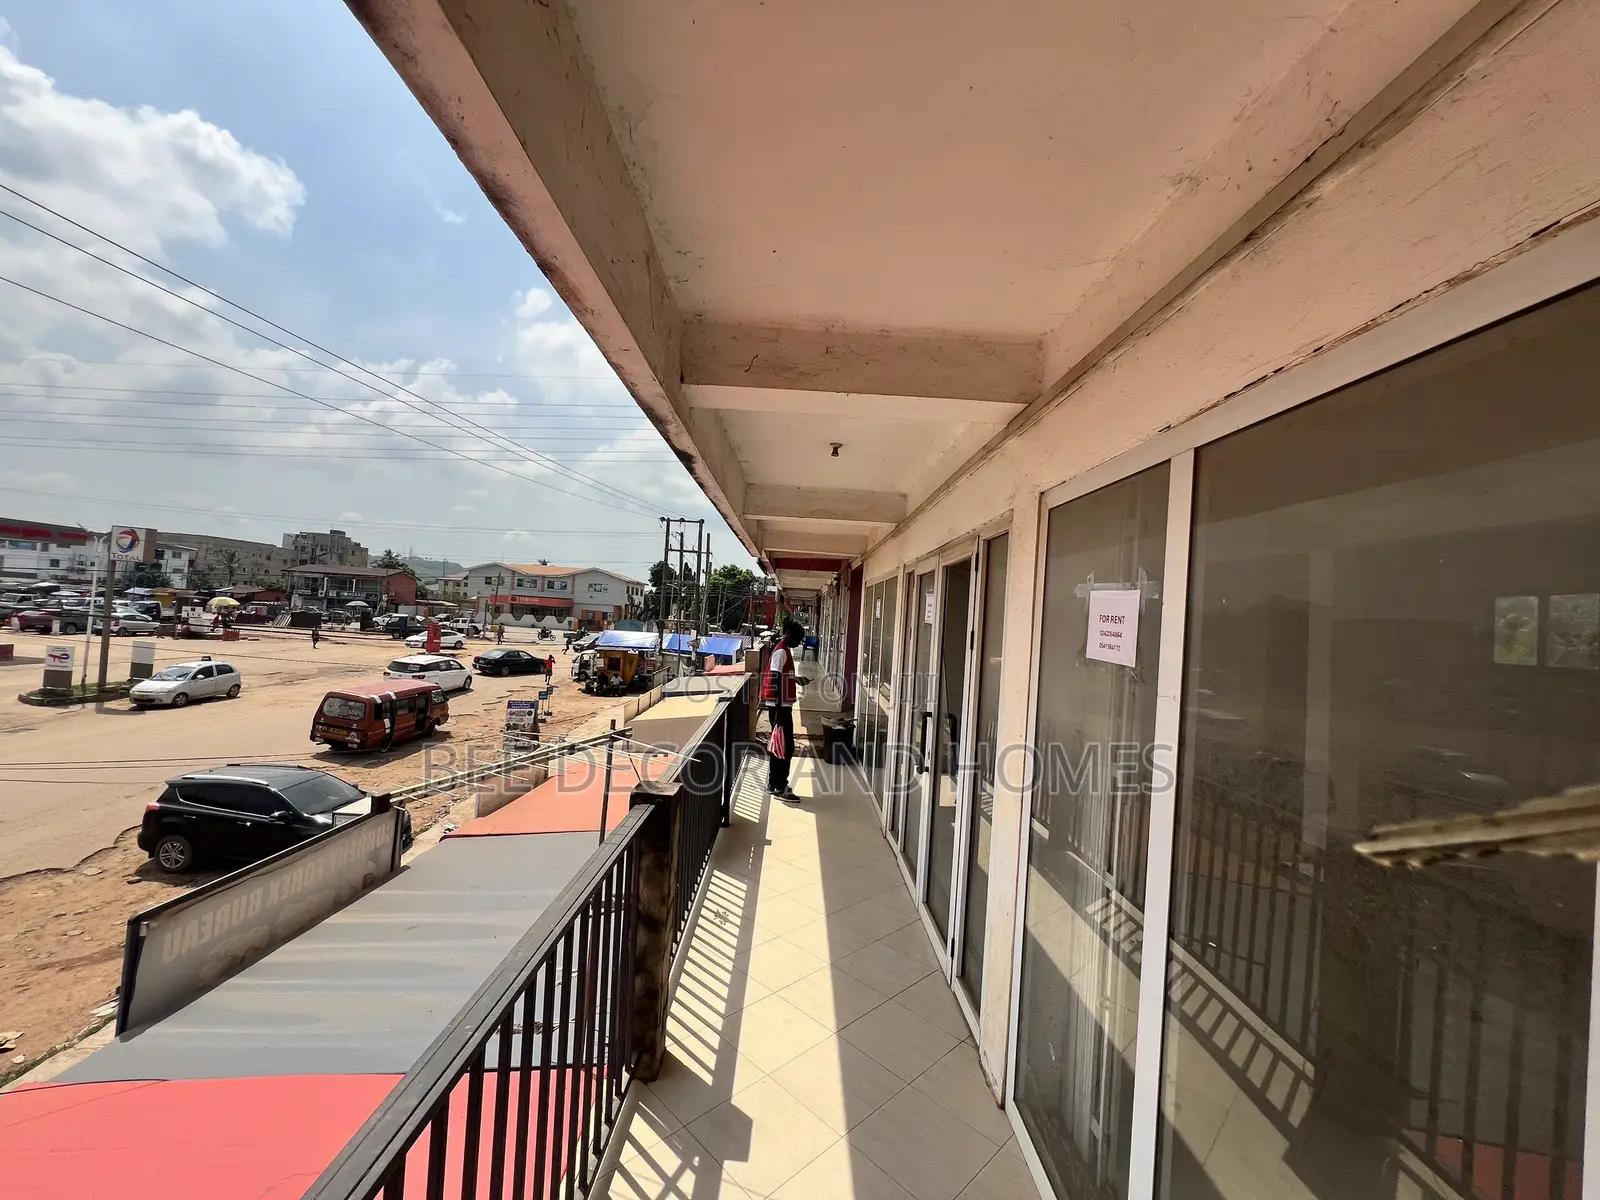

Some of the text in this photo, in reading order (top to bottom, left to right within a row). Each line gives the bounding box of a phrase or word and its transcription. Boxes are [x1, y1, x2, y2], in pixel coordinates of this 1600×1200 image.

[111, 552, 140, 562] TOTAL
[1099, 614, 1126, 624] FOR RENT
